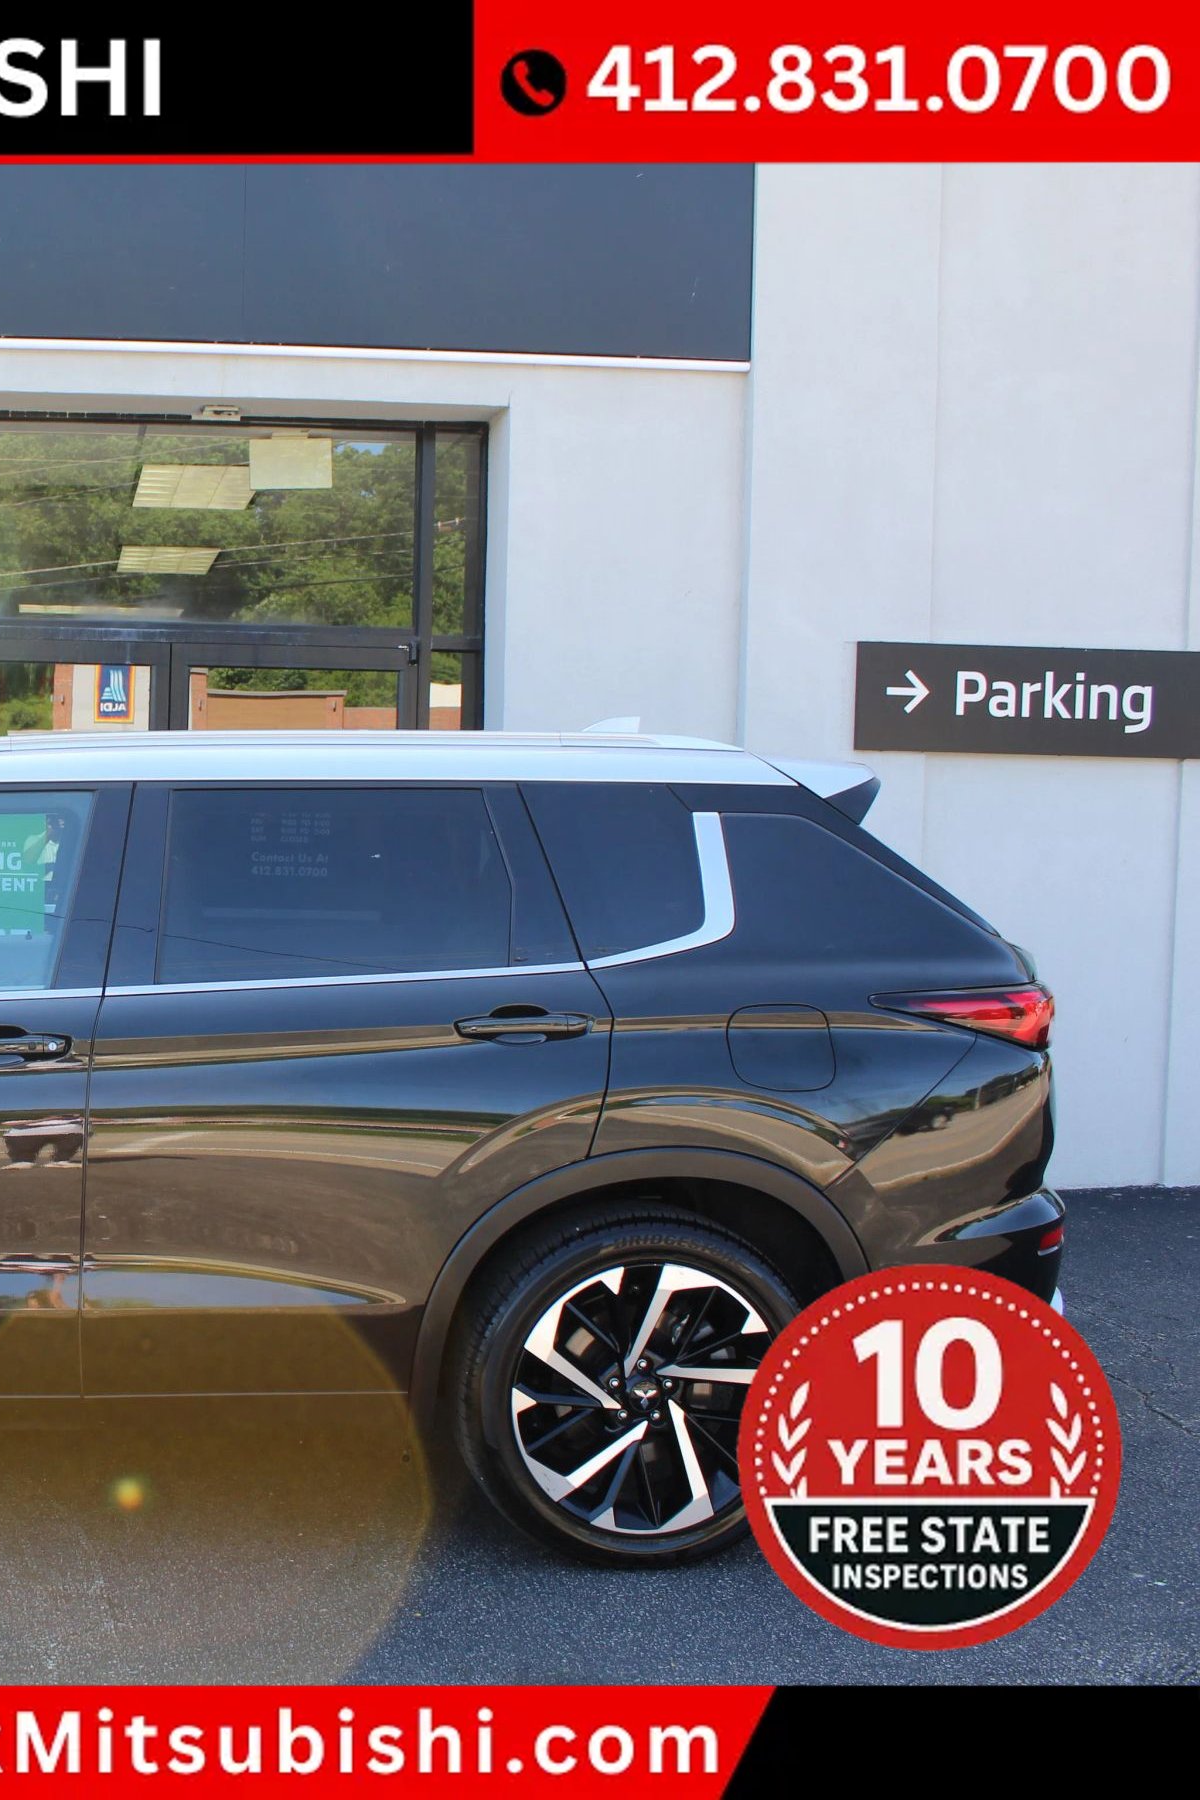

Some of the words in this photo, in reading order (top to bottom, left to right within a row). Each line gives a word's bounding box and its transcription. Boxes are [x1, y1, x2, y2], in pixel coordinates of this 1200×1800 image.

[955, 670, 1153, 734] Parking
[250, 851, 295, 862] Contact
[250, 865, 329, 877] 412.831.0700
